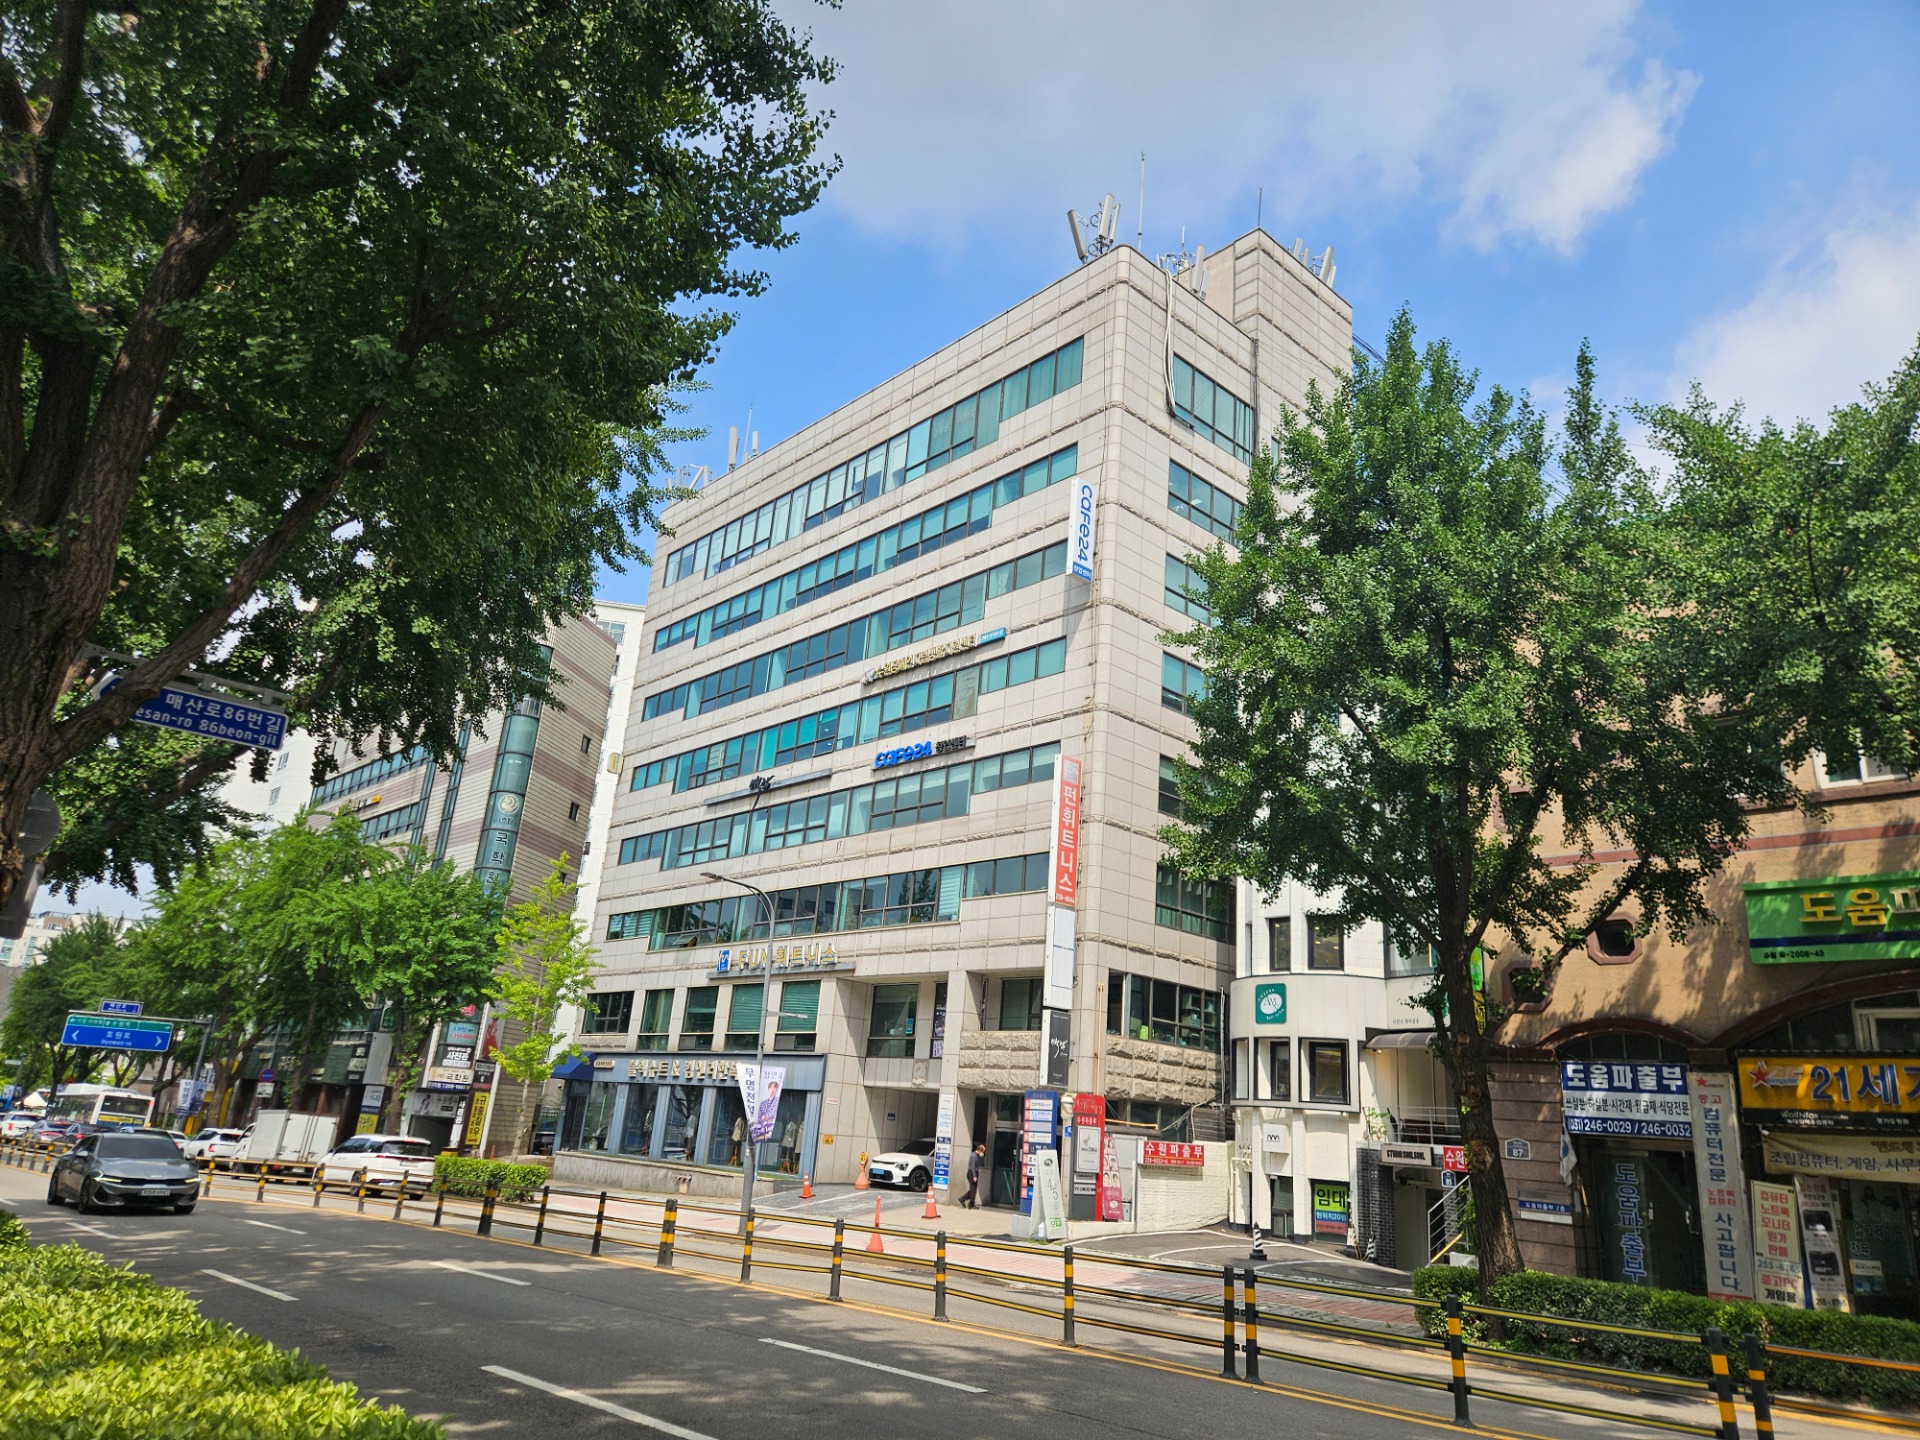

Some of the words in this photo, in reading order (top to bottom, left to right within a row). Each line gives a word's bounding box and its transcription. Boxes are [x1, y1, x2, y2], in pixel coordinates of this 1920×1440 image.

[165, 692, 281, 736] 매산로86번길
[135, 706, 193, 730] esan-ro
[199, 718, 278, 747] 86beon-gil
[1058, 783, 1077, 893] 펀휘트니스
[777, 942, 838, 969] 휘트니스
[105, 1030, 132, 1040] 효원로
[1566, 1064, 1684, 1092] 도움파출부
[1698, 1095, 1722, 1105] 중고
[1584, 1119, 1632, 1134] 246-0029
[1641, 1122, 1692, 1137] 246-0032
[1703, 1107, 1726, 1183] 컴퓨터전문
[1512, 1149, 1524, 1158] 87
[1316, 1188, 1346, 1209] 임대
[1759, 1190, 1789, 1204] 컴퓨터
[1525, 1202, 1554, 1211] 도움파출부
[1760, 1203, 1790, 1218] 노트북
[1615, 1162, 1647, 1283] 도움파출부
[1761, 1216, 1791, 1232] 모니터
[1767, 1231, 1788, 1244] 원가
[1768, 1244, 1789, 1258] 판매
[1761, 1274, 1799, 1289] 중고PC
[1765, 1288, 1797, 1304] 게임용
